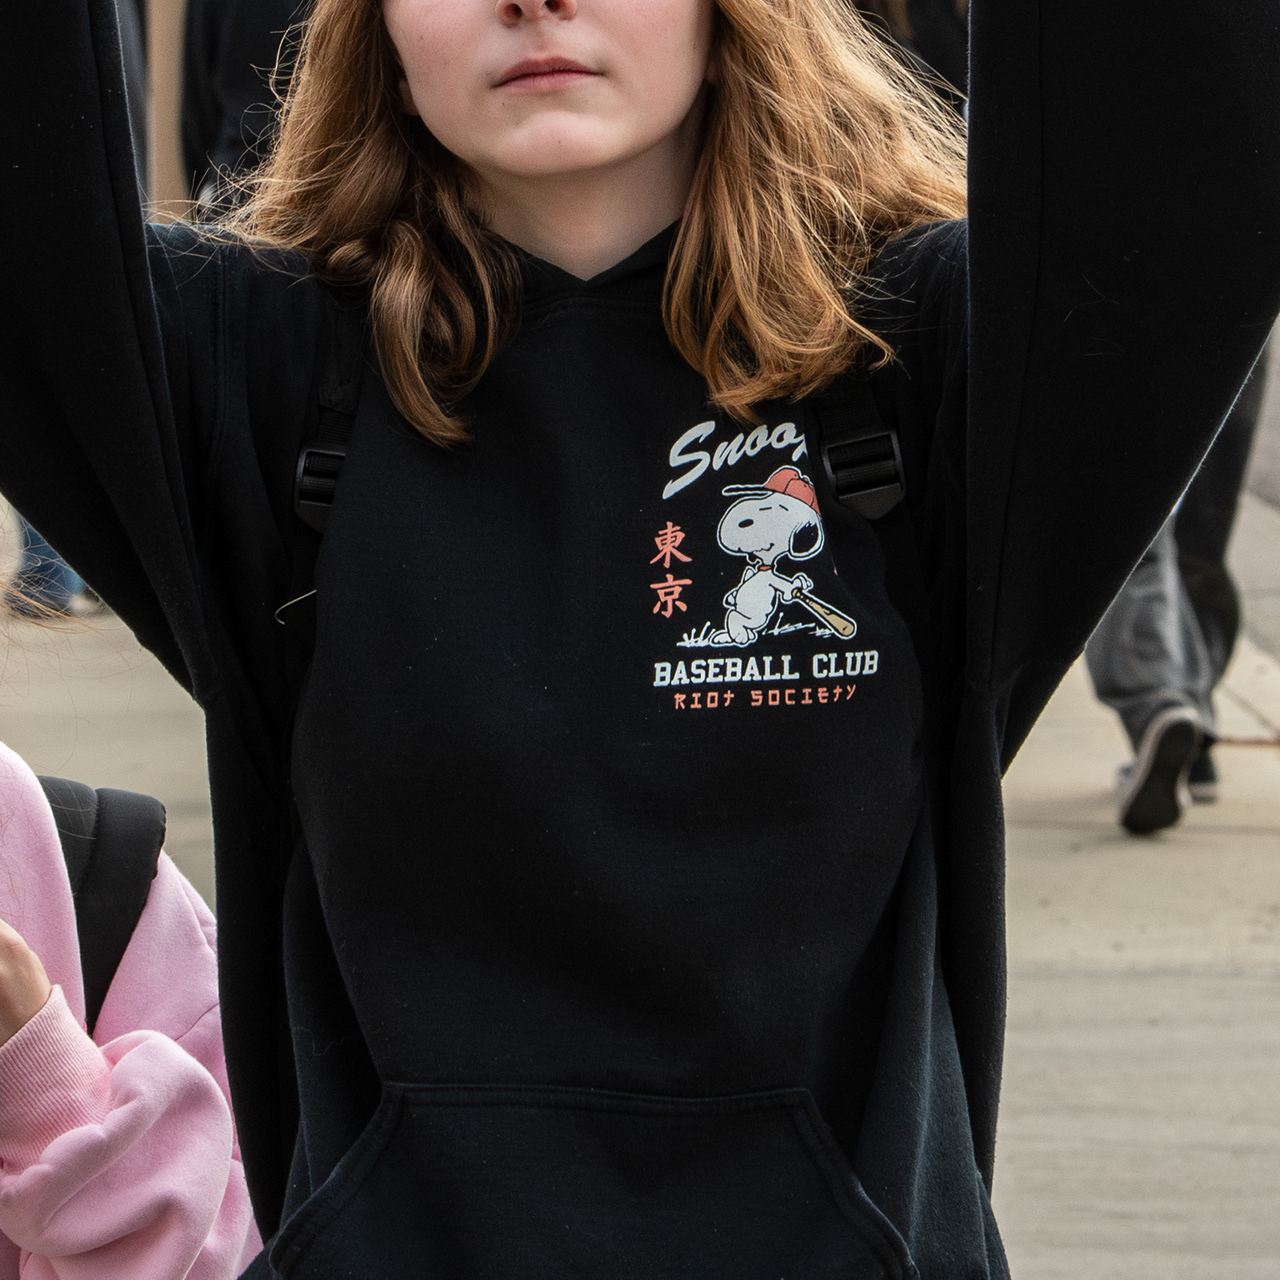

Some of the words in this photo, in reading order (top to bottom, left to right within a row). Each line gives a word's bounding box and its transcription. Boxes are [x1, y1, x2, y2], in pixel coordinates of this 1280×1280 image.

[649, 520, 693, 619] 東京
[652, 652, 800, 688] BASEBALL
[812, 649, 881, 680] CLUB
